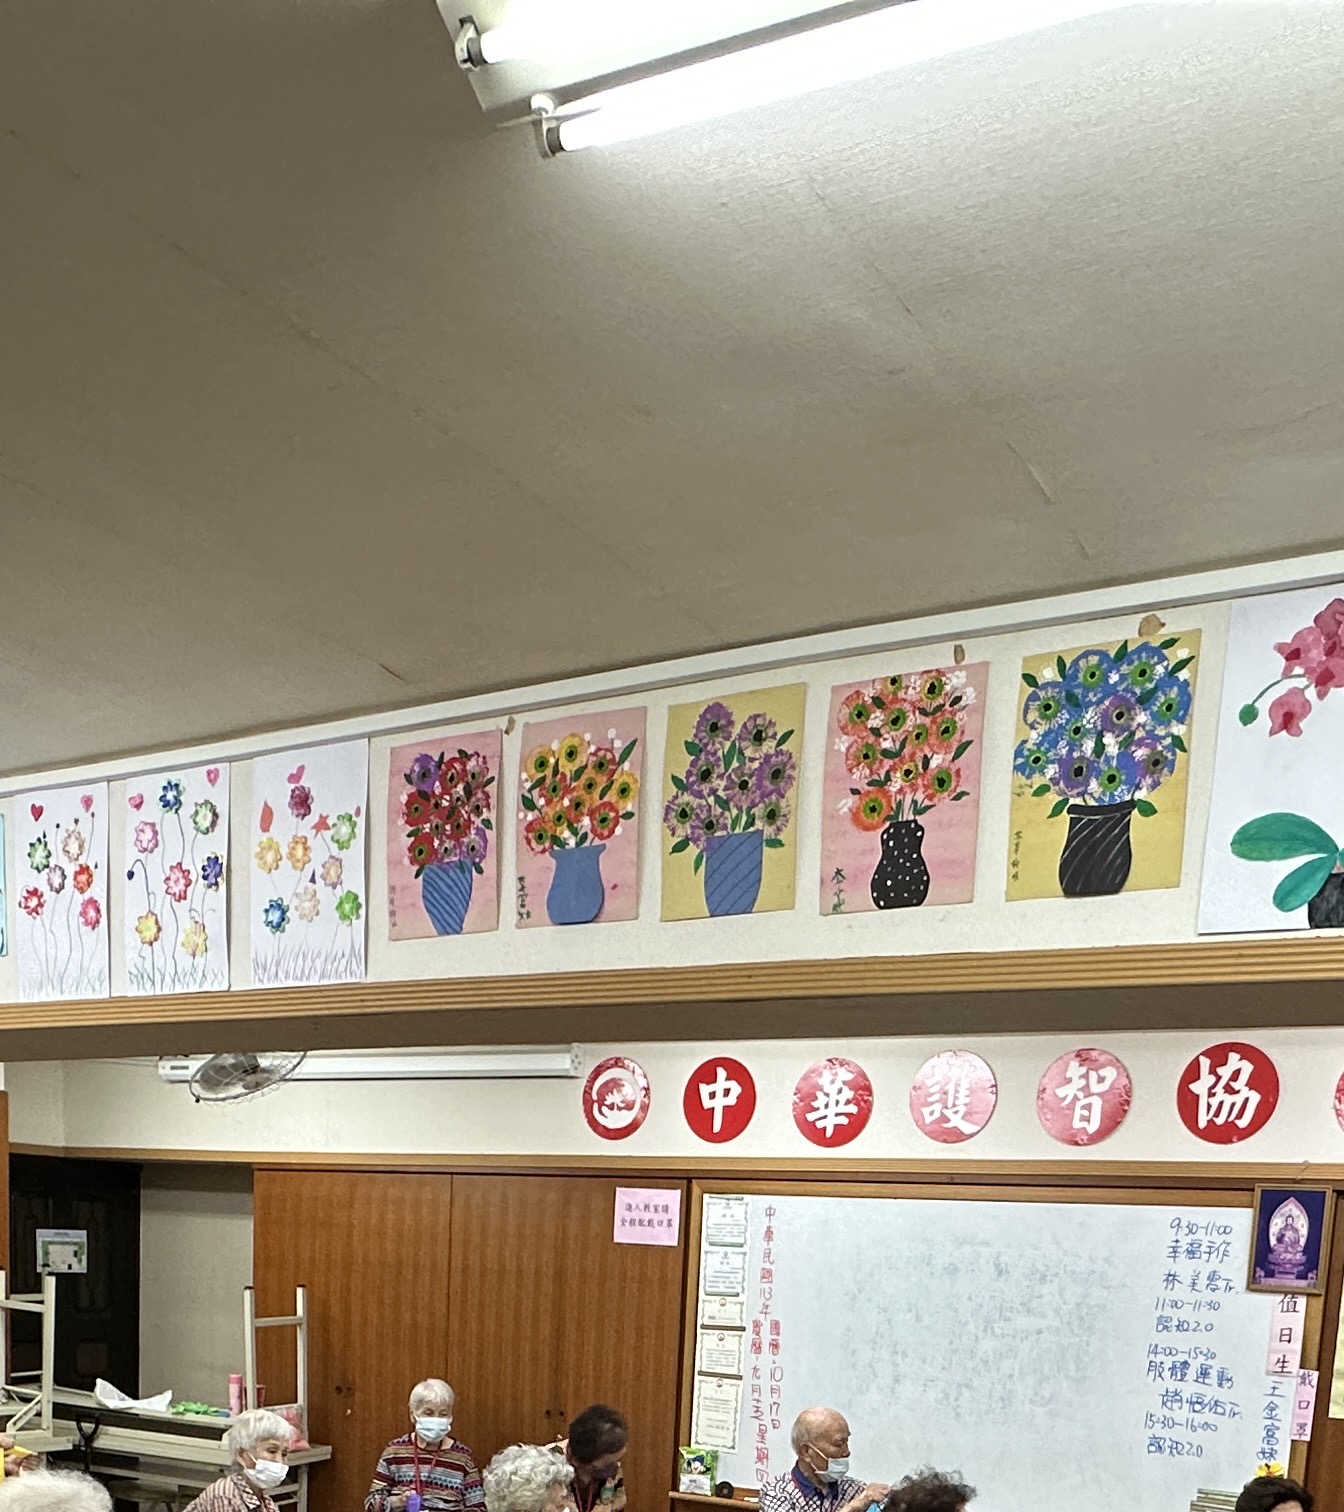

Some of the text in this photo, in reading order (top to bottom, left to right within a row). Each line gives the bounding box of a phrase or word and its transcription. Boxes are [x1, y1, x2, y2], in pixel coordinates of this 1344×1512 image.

[1166, 1238, 1232, 1264] 幸福手作
[1271, 1293, 1301, 1375] 值日生
[1293, 1371, 1315, 1438] 戴口罩
